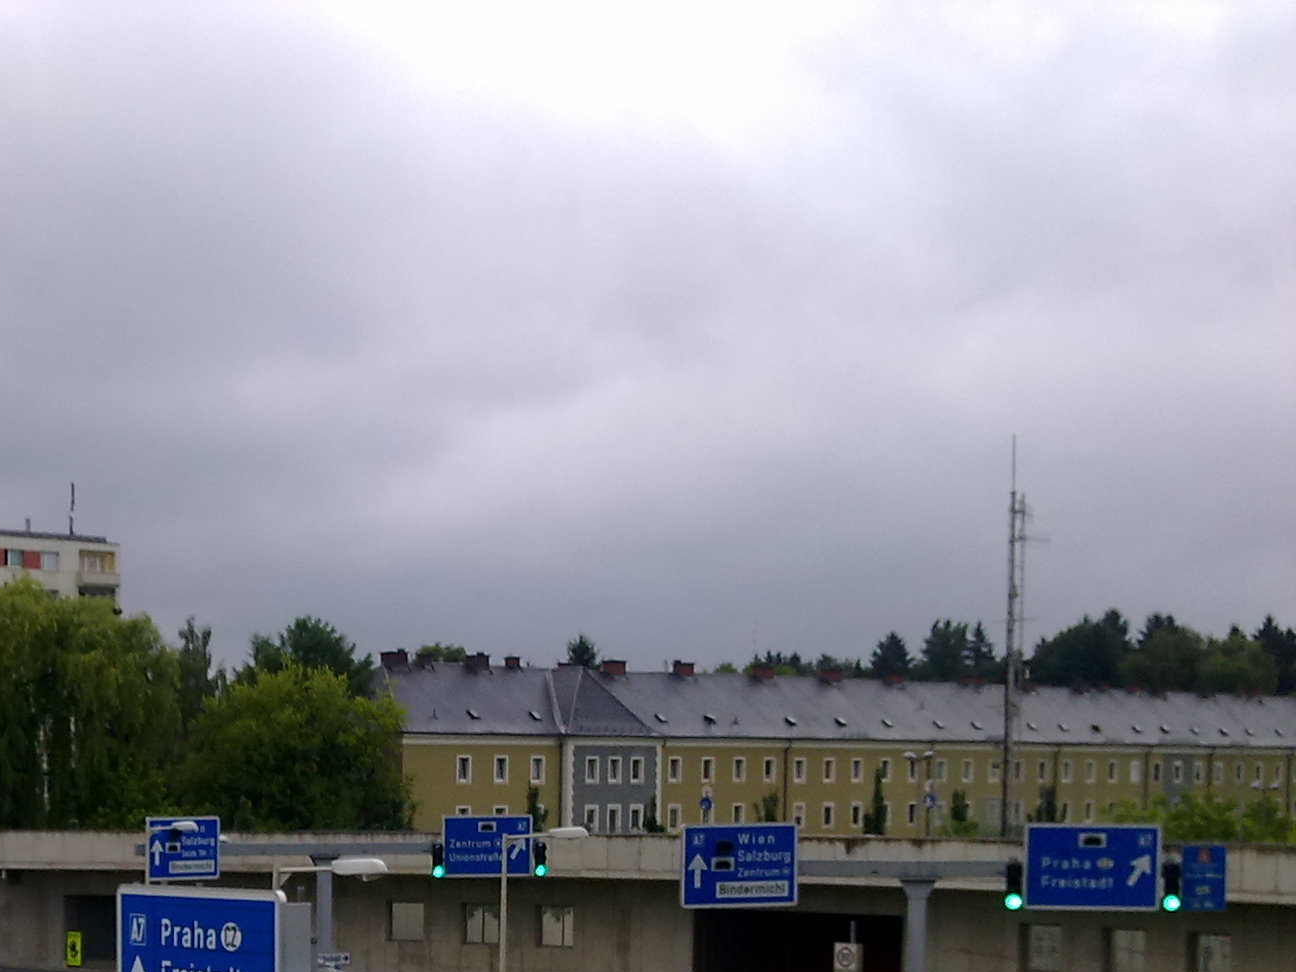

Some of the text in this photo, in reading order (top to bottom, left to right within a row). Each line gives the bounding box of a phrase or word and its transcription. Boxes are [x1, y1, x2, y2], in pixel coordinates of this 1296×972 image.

[449, 839, 492, 849] Zentrum
[737, 833, 776, 845] Wien
[737, 849, 792, 864] Salzburg
[1041, 856, 1092, 870] Praha
[1041, 875, 1114, 889] Freistadt
[131, 916, 145, 942] A7
[161, 918, 238, 950] Praha CZ
